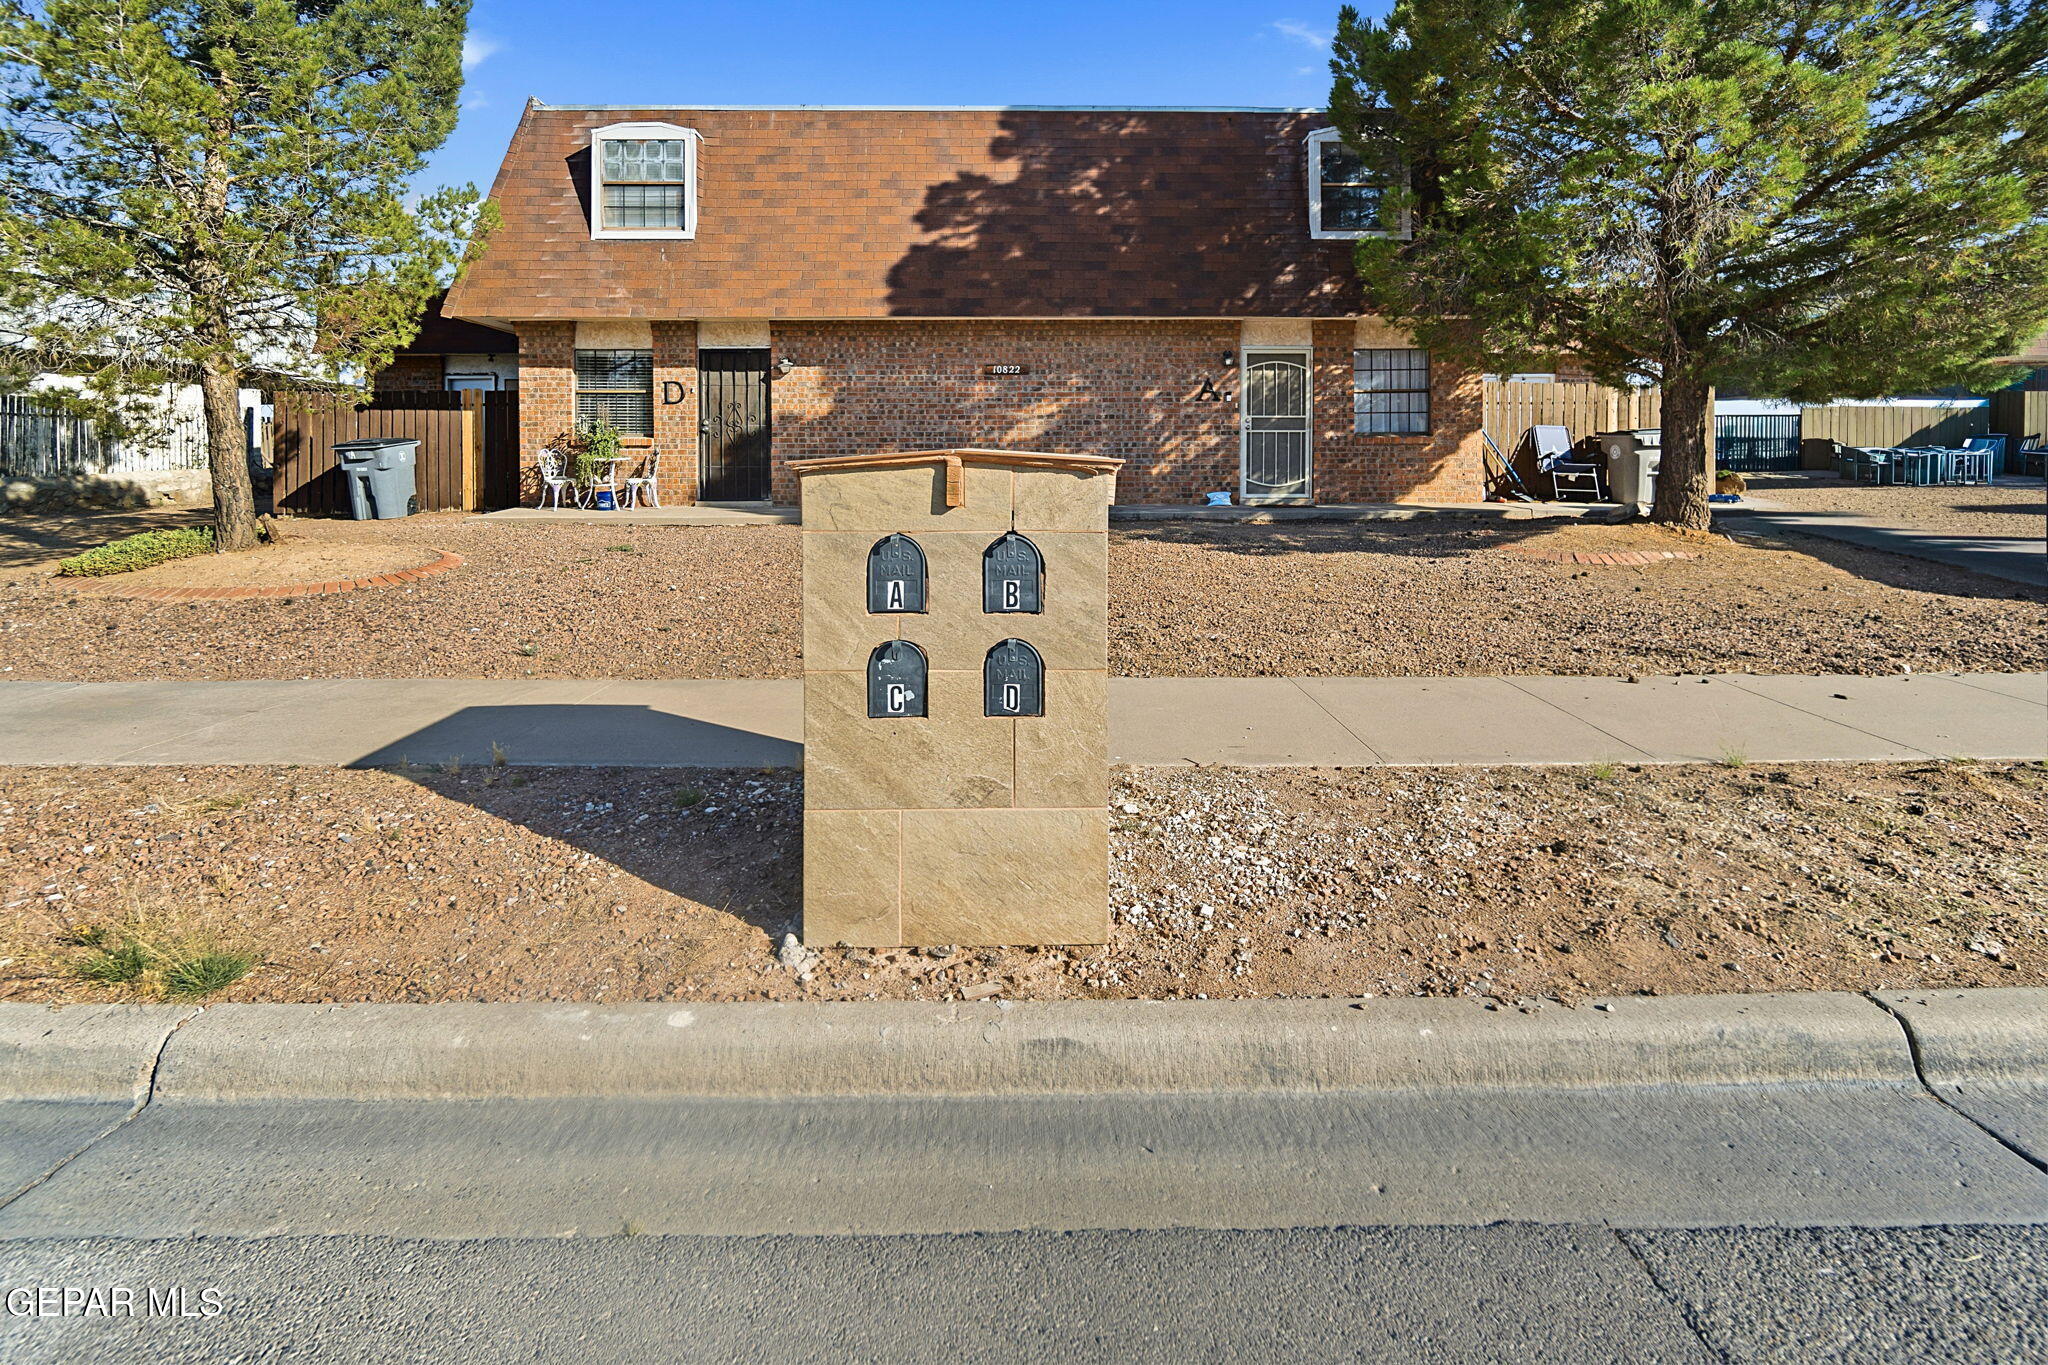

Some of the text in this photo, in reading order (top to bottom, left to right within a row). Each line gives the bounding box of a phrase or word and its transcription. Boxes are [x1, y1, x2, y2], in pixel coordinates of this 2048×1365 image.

[993, 365, 1021, 374] 10822
[662, 381, 686, 405] D
[1195, 378, 1221, 402] A
[880, 564, 914, 577] MAIL
[995, 564, 1030, 577] MAIL
[889, 581, 903, 608] A
[1006, 581, 1019, 608] B
[890, 685, 903, 712] C
[1006, 685, 1019, 711] D
